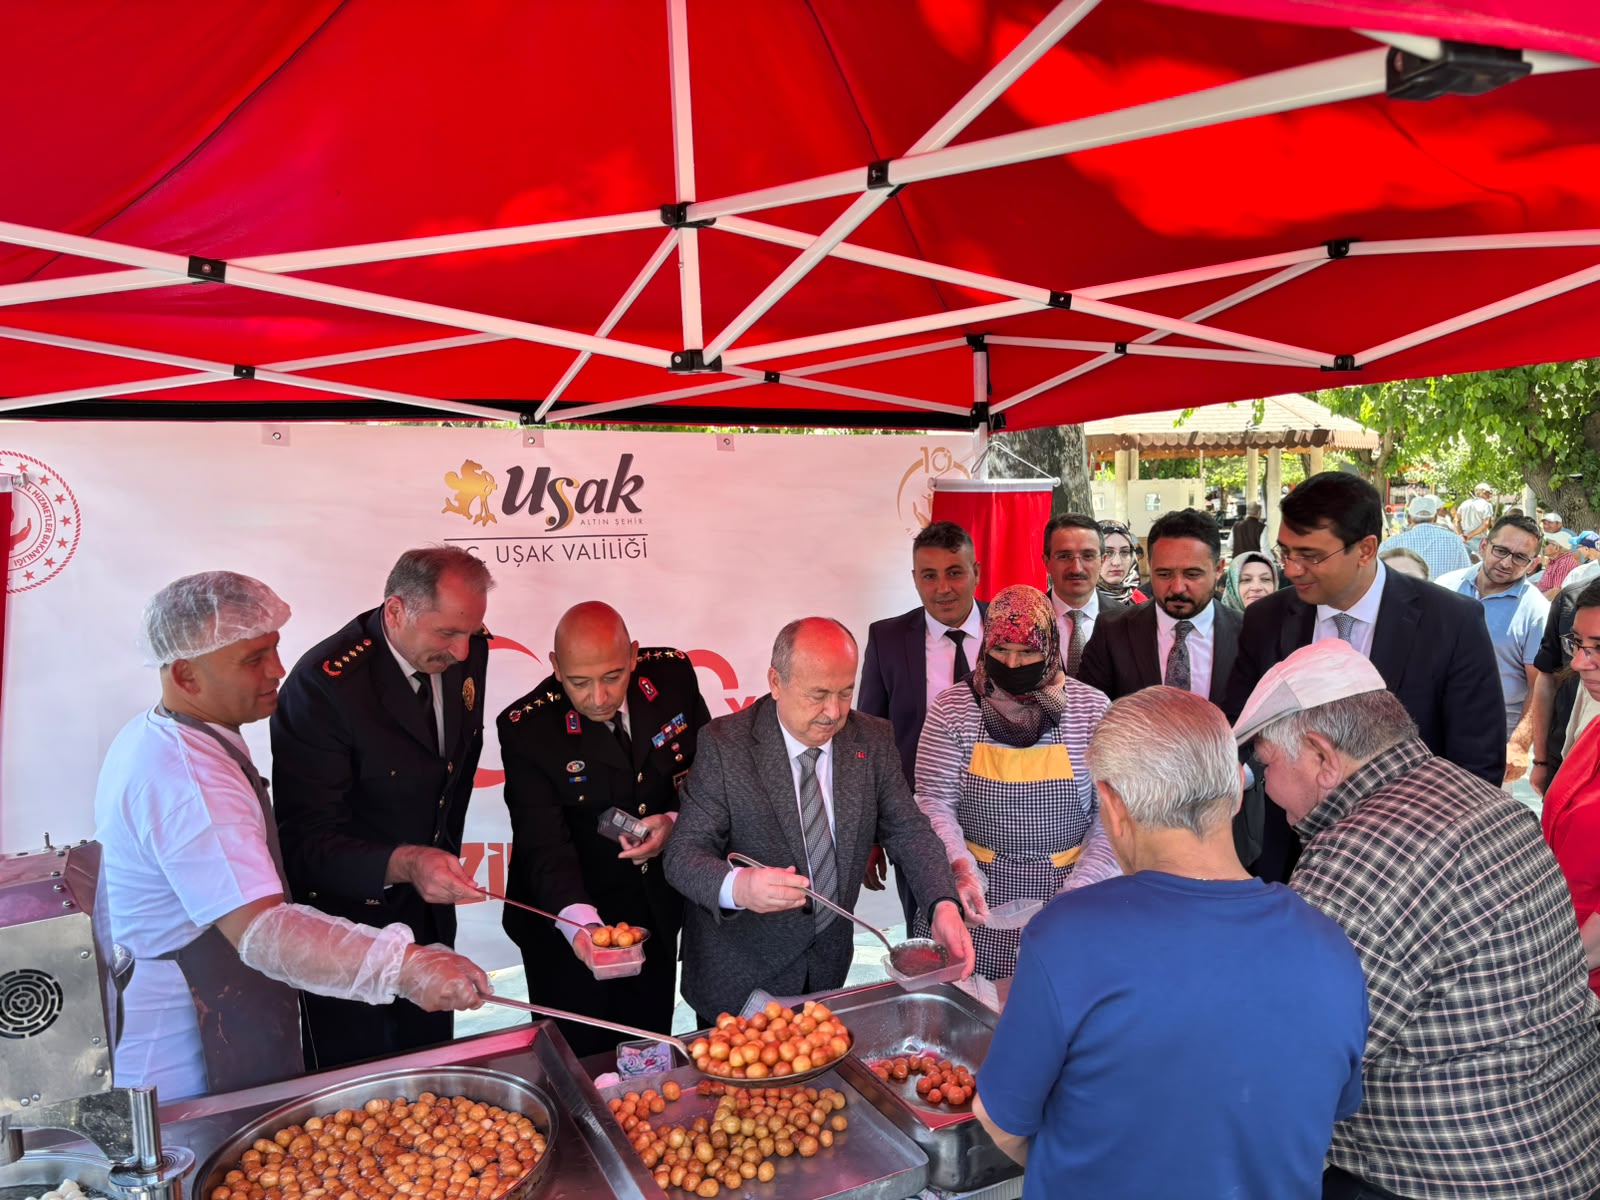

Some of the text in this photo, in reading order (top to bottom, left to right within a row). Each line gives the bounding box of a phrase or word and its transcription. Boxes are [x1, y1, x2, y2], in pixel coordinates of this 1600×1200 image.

[31, 489, 53, 534] HİZMETLER
[580, 516, 644, 527] ALTIN ŞEHİR
[13, 533, 51, 567] BAKANLIĞI
[496, 544, 555, 568] UŞAK
[562, 537, 648, 562] VALİLİĞİ
